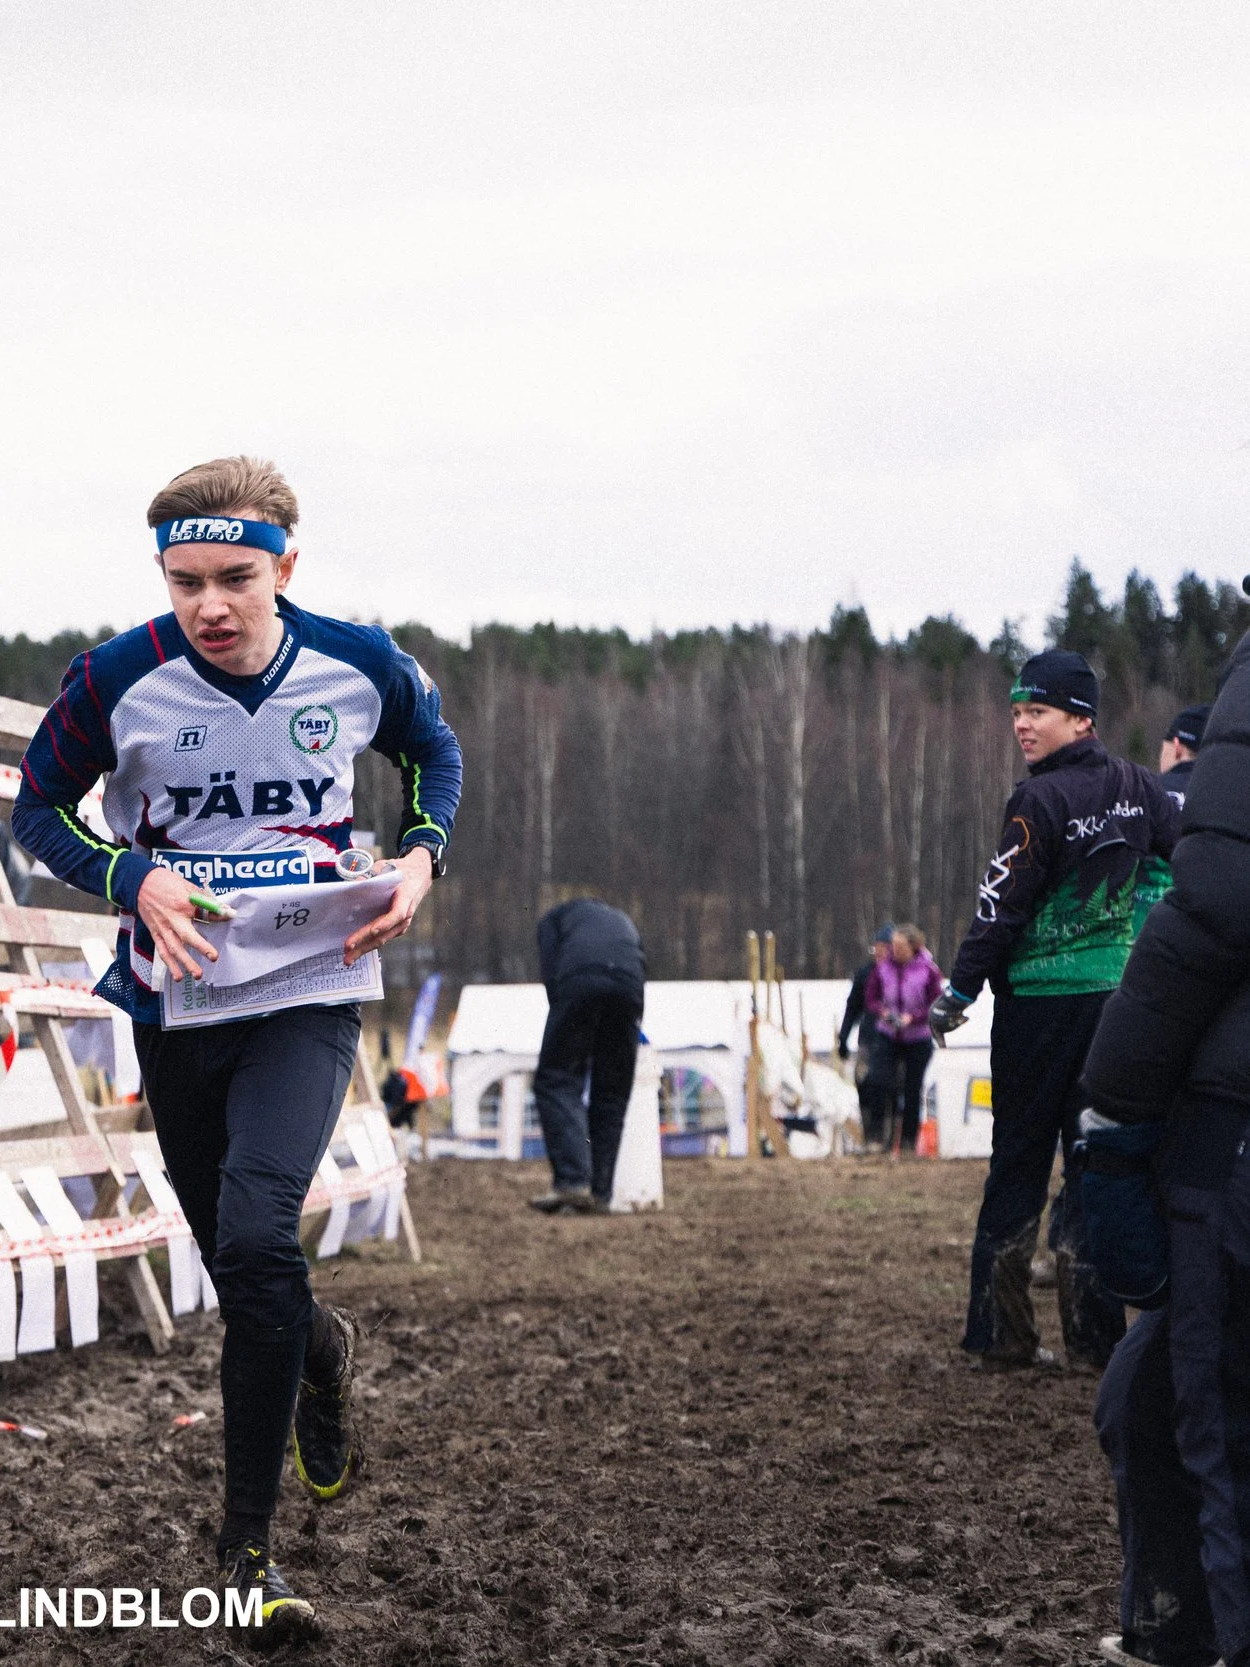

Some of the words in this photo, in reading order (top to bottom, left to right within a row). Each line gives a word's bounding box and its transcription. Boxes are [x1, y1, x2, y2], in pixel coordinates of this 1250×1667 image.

[169, 519, 244, 542] LETRO
[170, 531, 241, 541] SPORT
[261, 633, 294, 687] noname
[298, 719, 331, 731] TÄBY
[164, 770, 335, 821] TÄBY
[273, 908, 310, 930] 84
